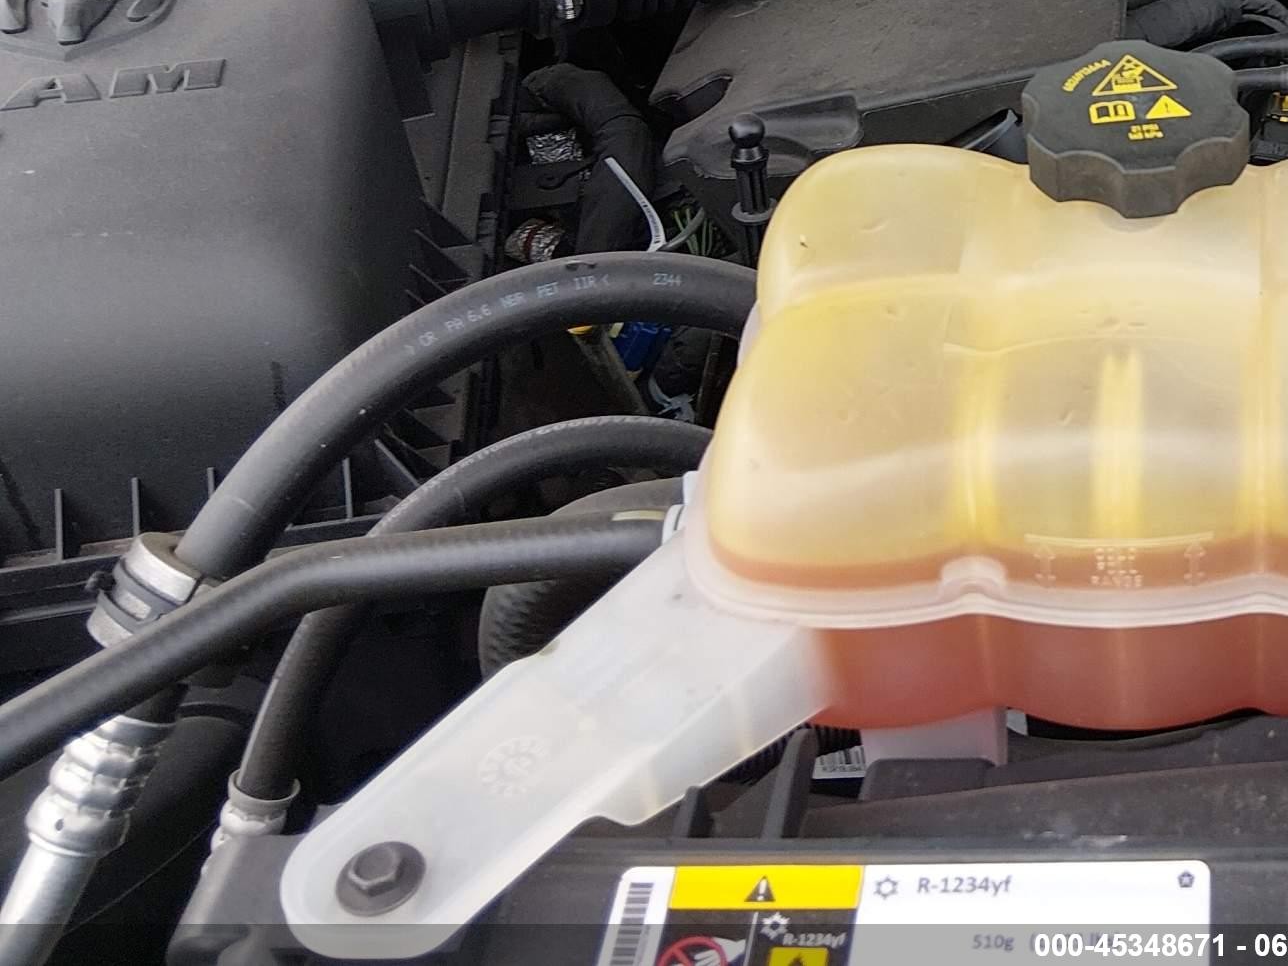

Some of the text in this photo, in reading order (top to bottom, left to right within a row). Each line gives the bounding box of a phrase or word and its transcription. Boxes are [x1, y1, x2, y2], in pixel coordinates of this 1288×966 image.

[652, 272, 683, 288] 2344
[536, 281, 561, 299] PET
[1090, 574, 1144, 588] RANGE
[917, 875, 1012, 897] R-1234yf
[782, 931, 848, 948] R-1234yf
[971, 933, 1015, 953] 510g
